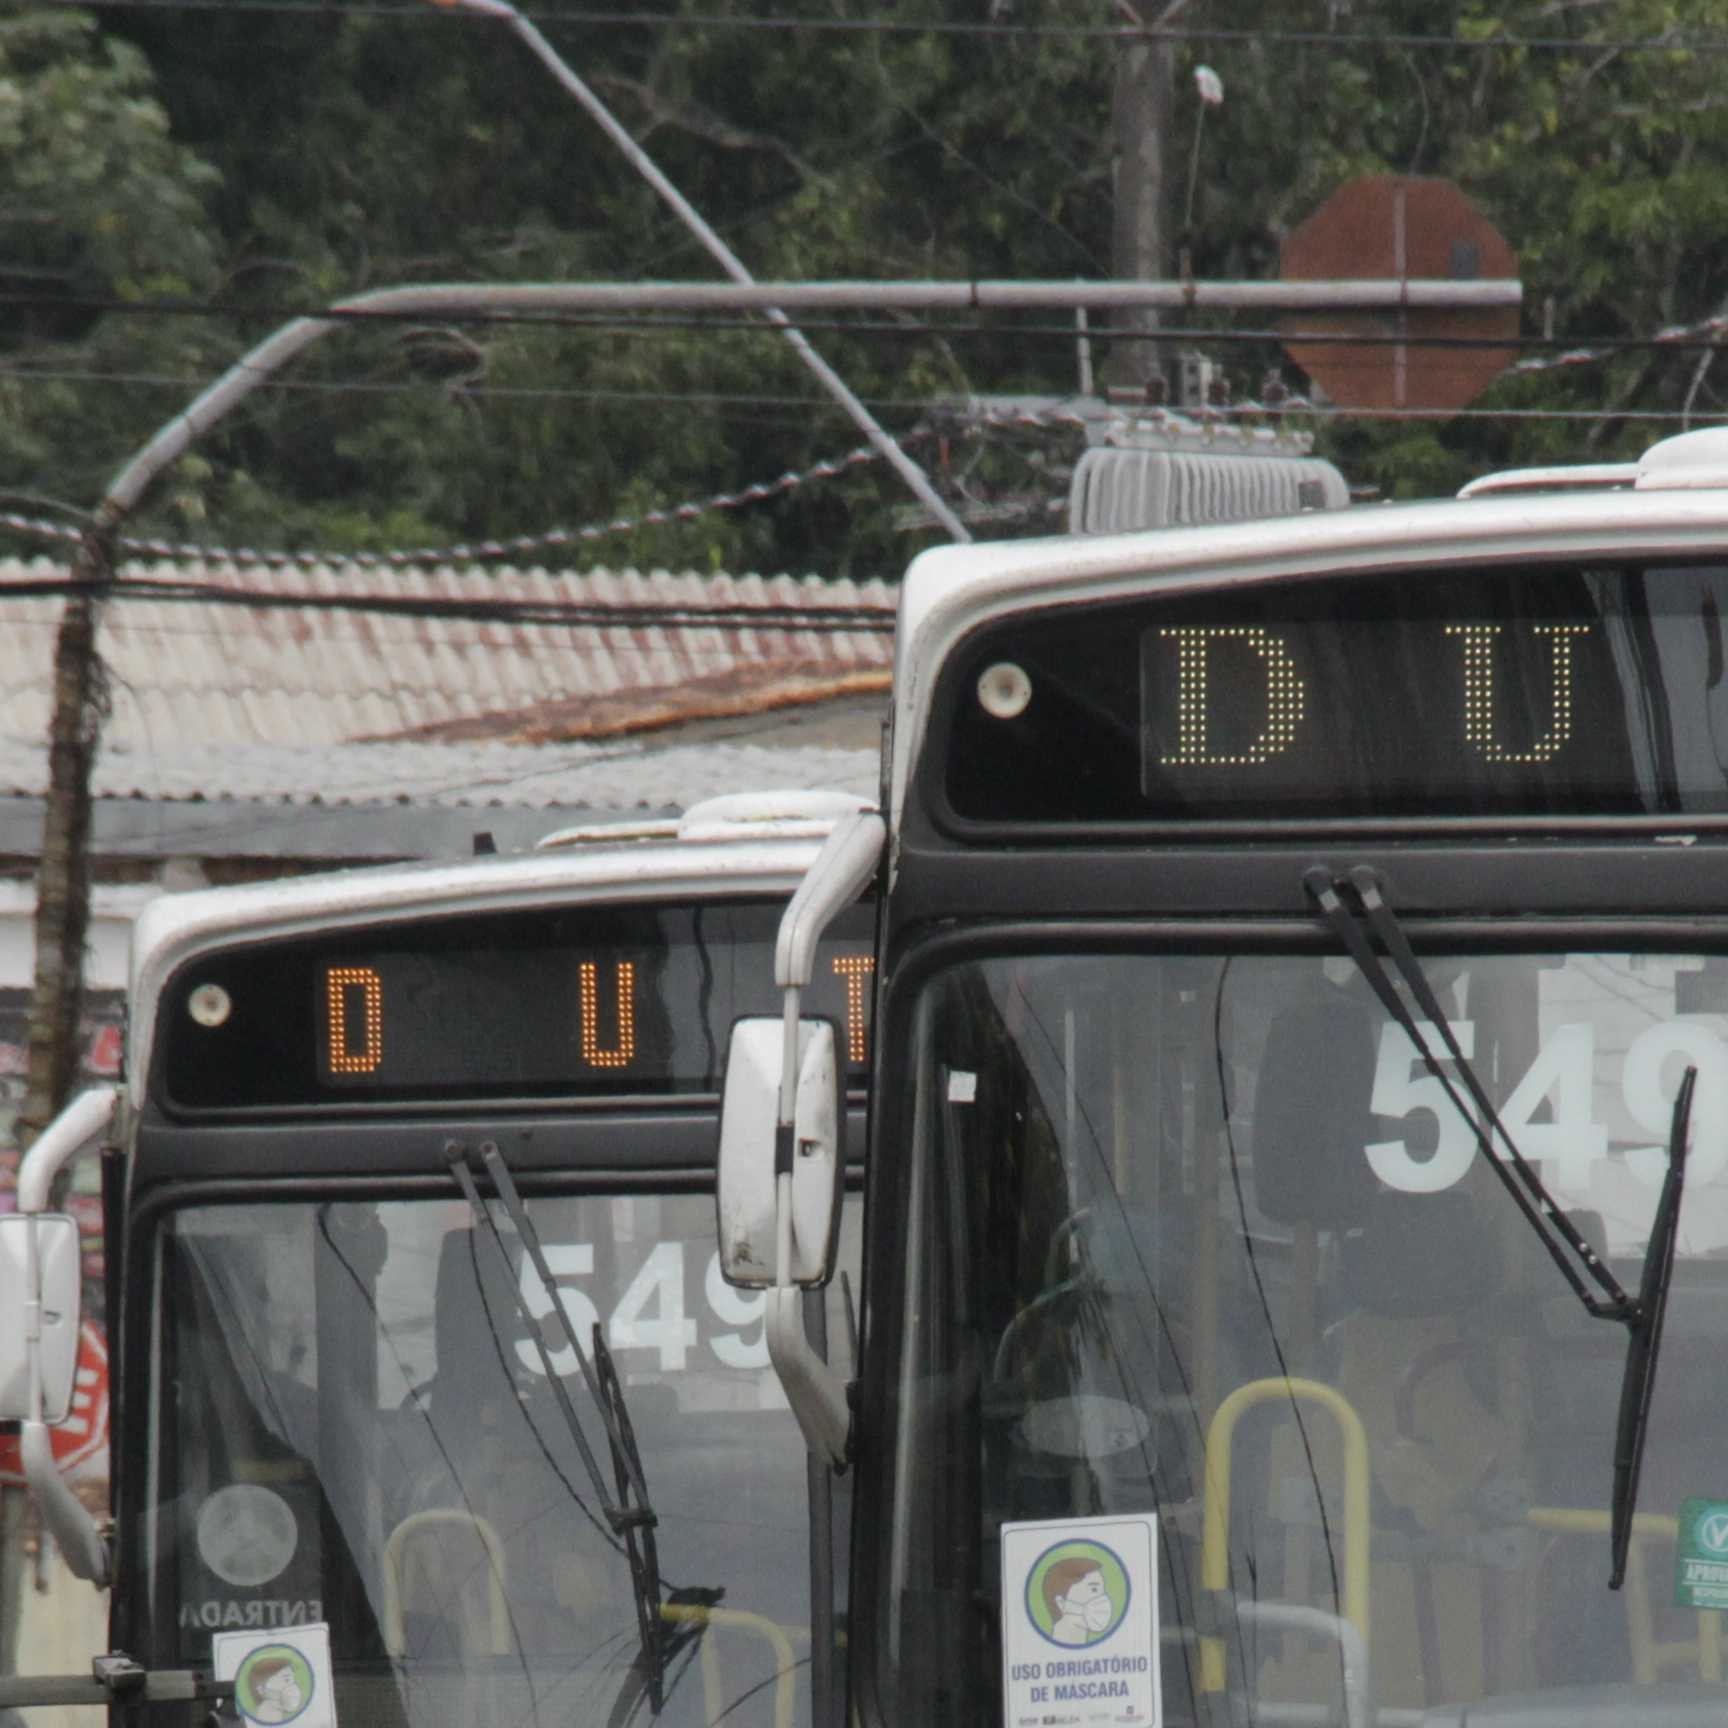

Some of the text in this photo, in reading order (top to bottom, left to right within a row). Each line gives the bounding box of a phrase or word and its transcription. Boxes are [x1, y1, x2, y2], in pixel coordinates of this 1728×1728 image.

[513, 1240, 773, 1377] 549
[1011, 1663, 1041, 1681] USO
[1030, 1686, 1048, 1702] DE
